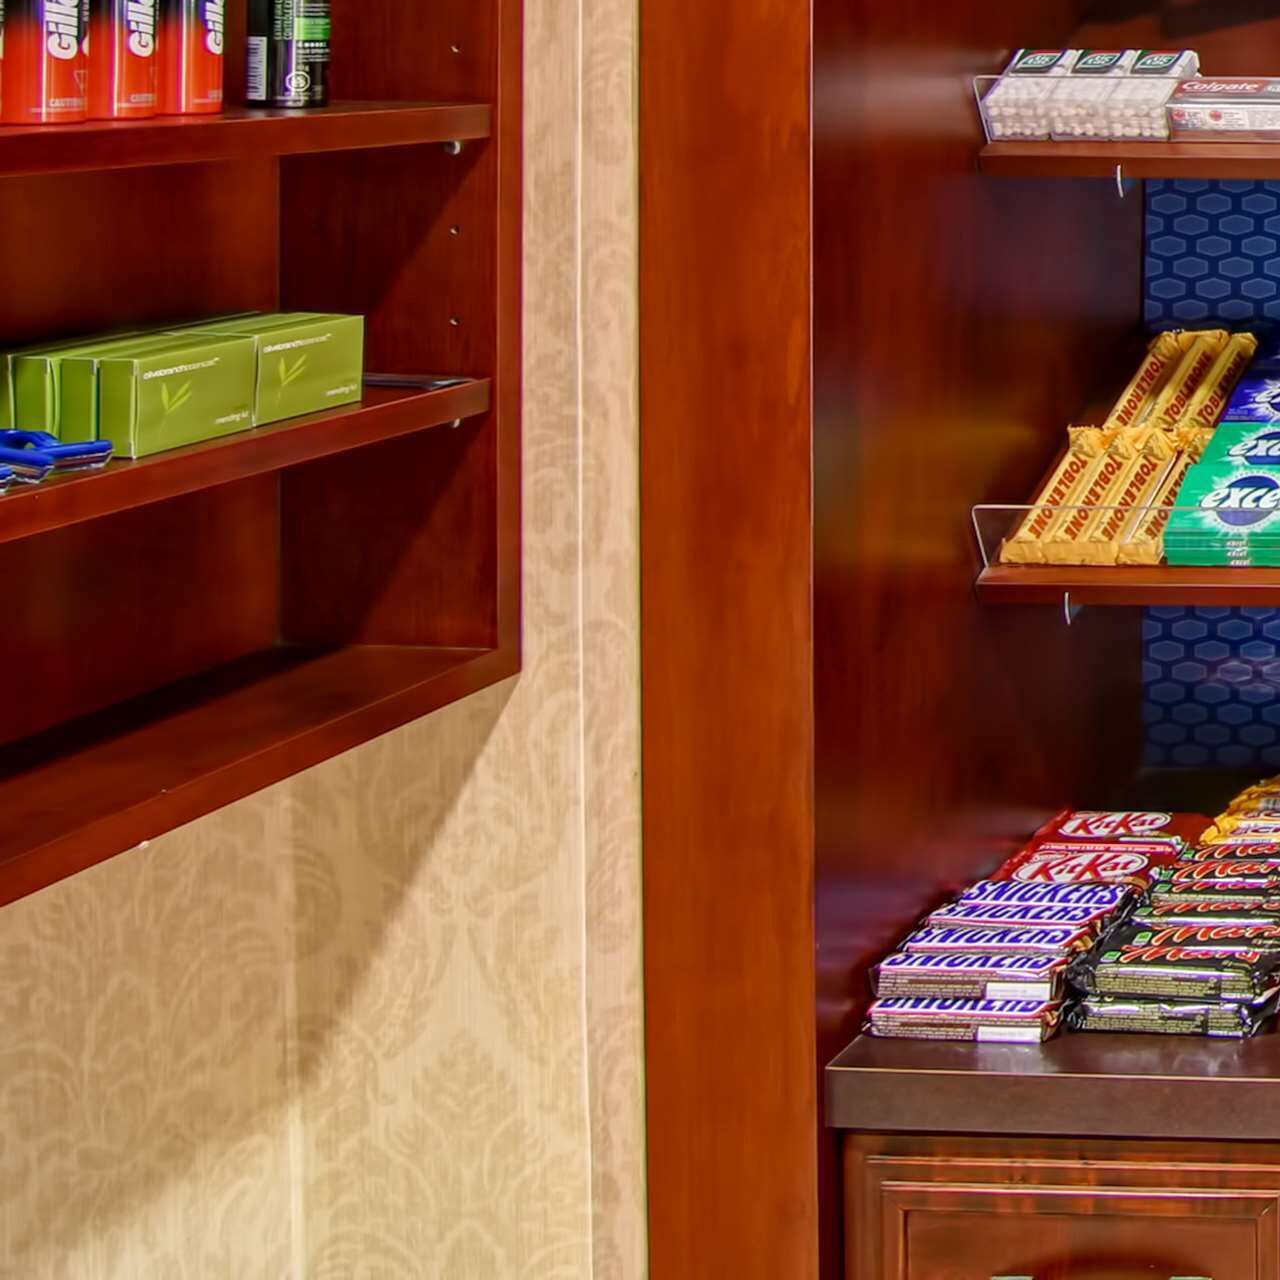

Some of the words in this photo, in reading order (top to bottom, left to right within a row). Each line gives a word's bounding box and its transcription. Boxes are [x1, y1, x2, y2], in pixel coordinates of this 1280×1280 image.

[1180, 80, 1260, 96] Colgate
[1116, 353, 1166, 426] TOBLERONE
[1163, 351, 1213, 426] TOBLERONE
[1196, 352, 1246, 425] TOBLERONE
[1028, 449, 1088, 540] TOBLERONE
[1064, 451, 1123, 541] TOBLERONE
[1101, 454, 1158, 542] TOBLERONE
[932, 904, 1101, 920] SNICKERS
[961, 882, 1127, 904] SNICKERS
[909, 928, 1075, 945] SNICKERS
[1119, 945, 1262, 964] Mars
